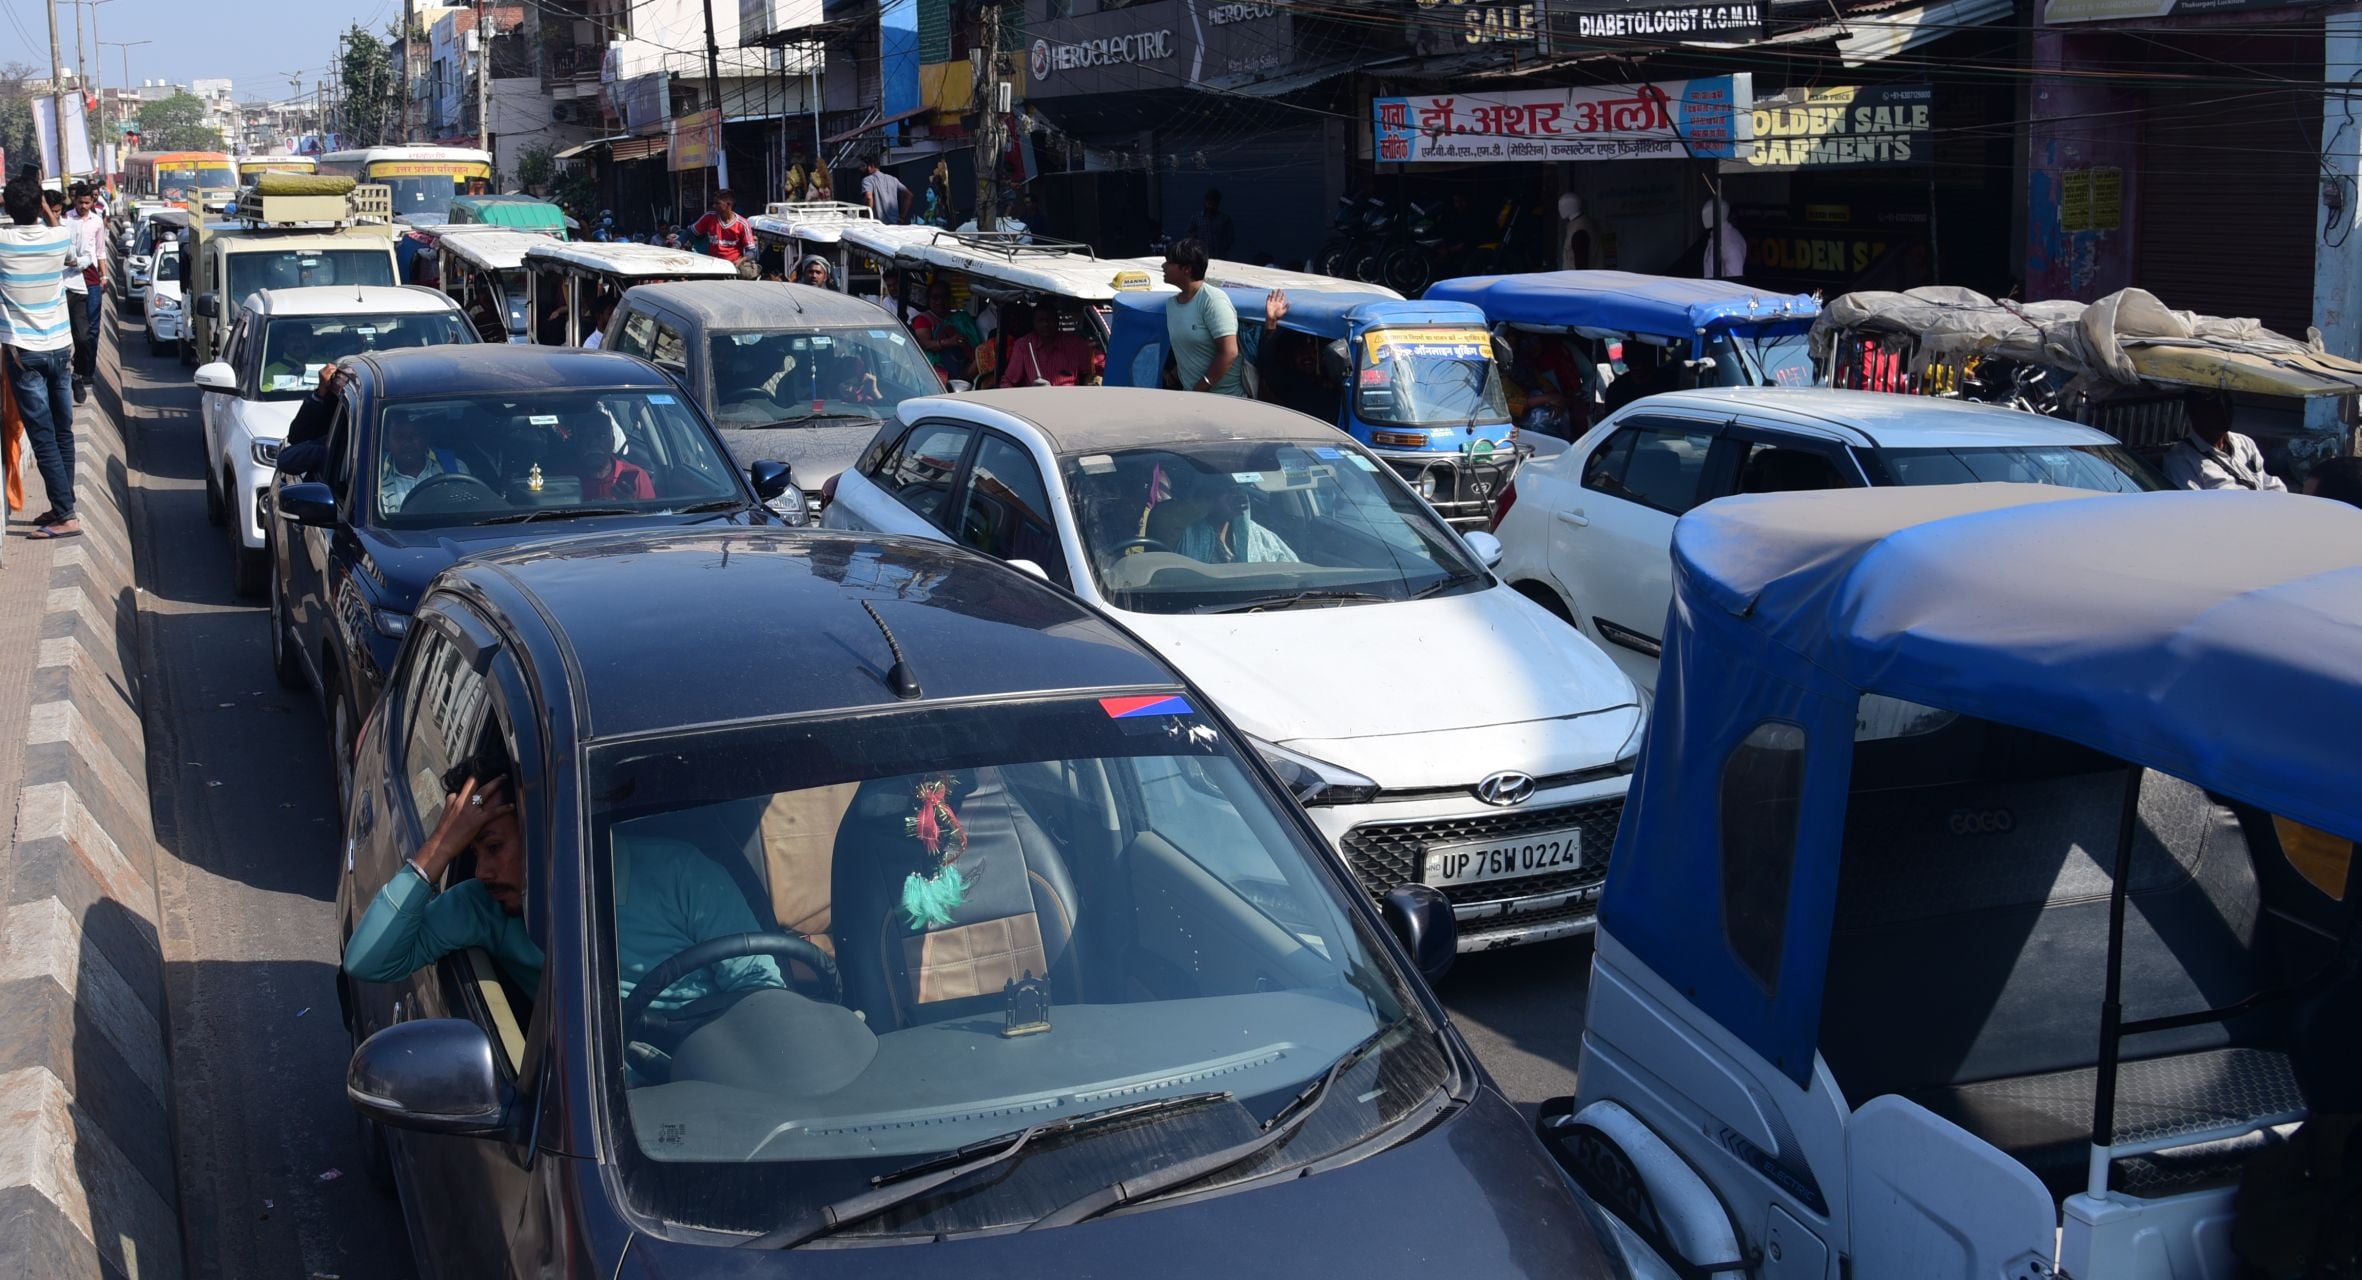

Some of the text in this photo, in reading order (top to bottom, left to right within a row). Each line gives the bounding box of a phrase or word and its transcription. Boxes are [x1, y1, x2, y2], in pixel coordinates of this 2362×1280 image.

[1465, 4, 1536, 44] SALE
[1579, 5, 1762, 37] DIABETOLOGIST K.G.M.U.
[1573, 85, 1671, 133] अली
[1752, 105, 1930, 136] OLDEN SALE
[1747, 134, 1911, 166] GARMENTS
[1443, 839, 1574, 880] UP 76W 0224
